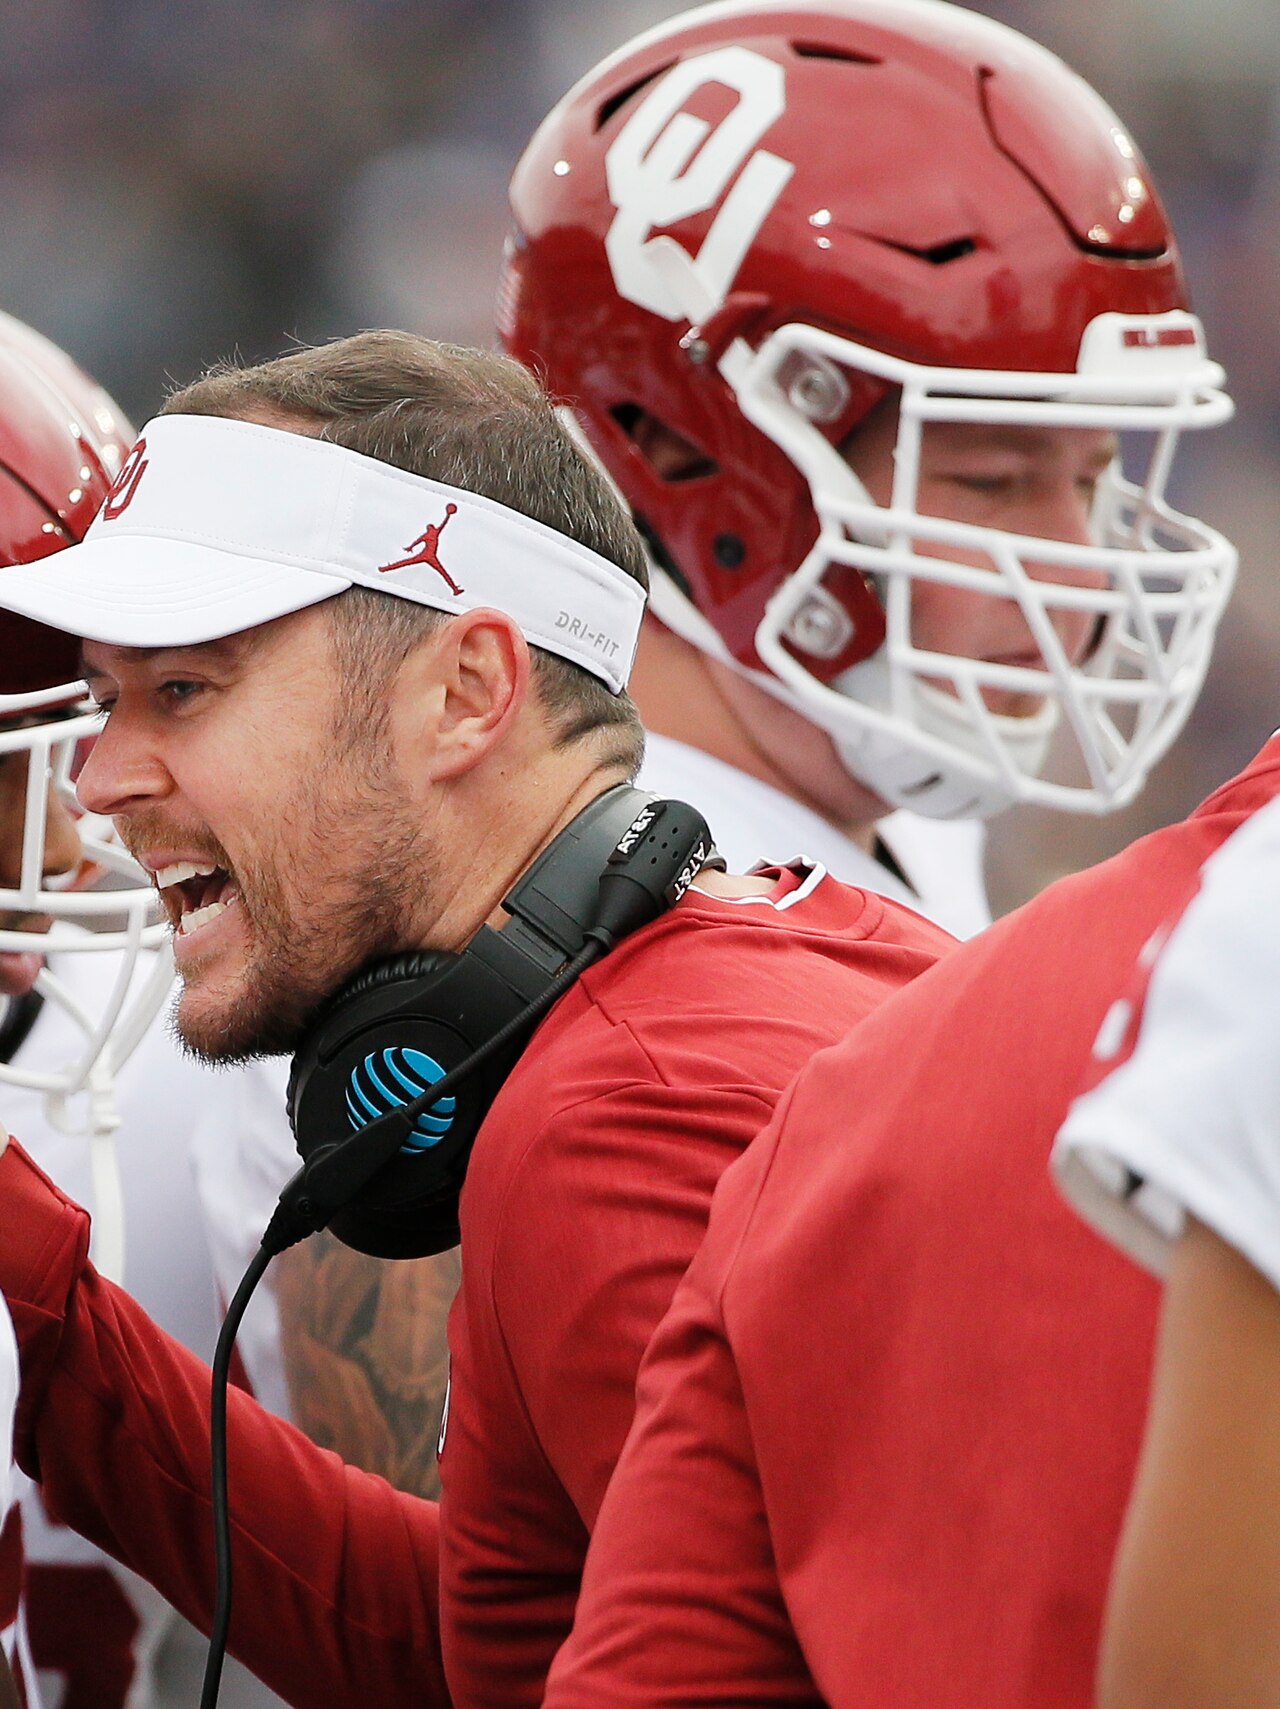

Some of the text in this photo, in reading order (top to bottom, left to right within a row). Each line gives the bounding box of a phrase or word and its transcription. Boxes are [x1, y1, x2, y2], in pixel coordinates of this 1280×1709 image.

[605, 46, 795, 322] OU
[554, 610, 620, 657] DRI-FIT
[616, 808, 656, 854] AT&T
[674, 841, 707, 901] AT&T
